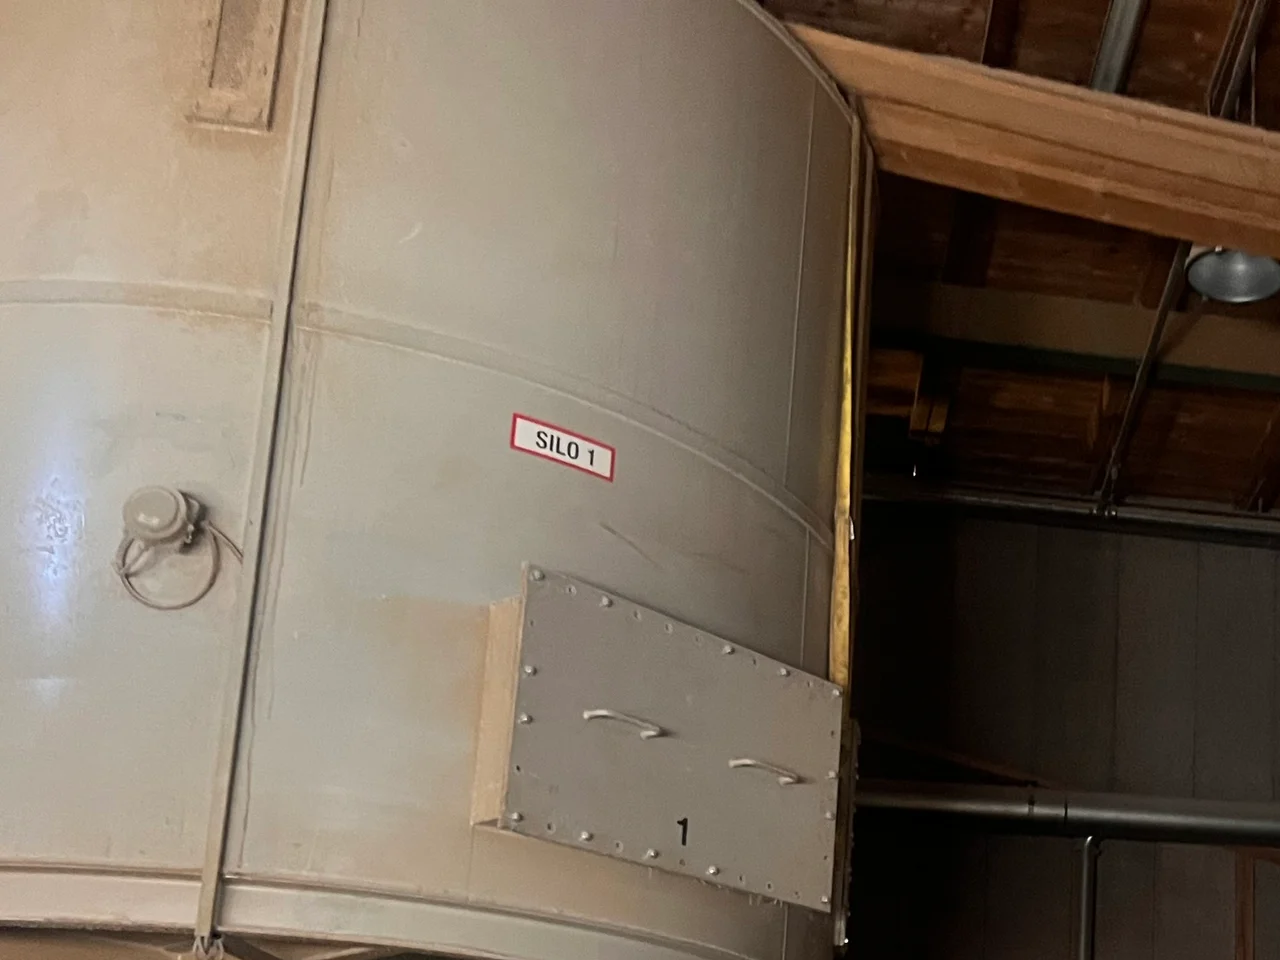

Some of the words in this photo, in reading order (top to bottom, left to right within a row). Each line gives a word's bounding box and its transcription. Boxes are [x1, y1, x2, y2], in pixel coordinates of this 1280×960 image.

[535, 430, 579, 460] SILO
[587, 449, 595, 467] 1
[676, 817, 688, 846] 1
